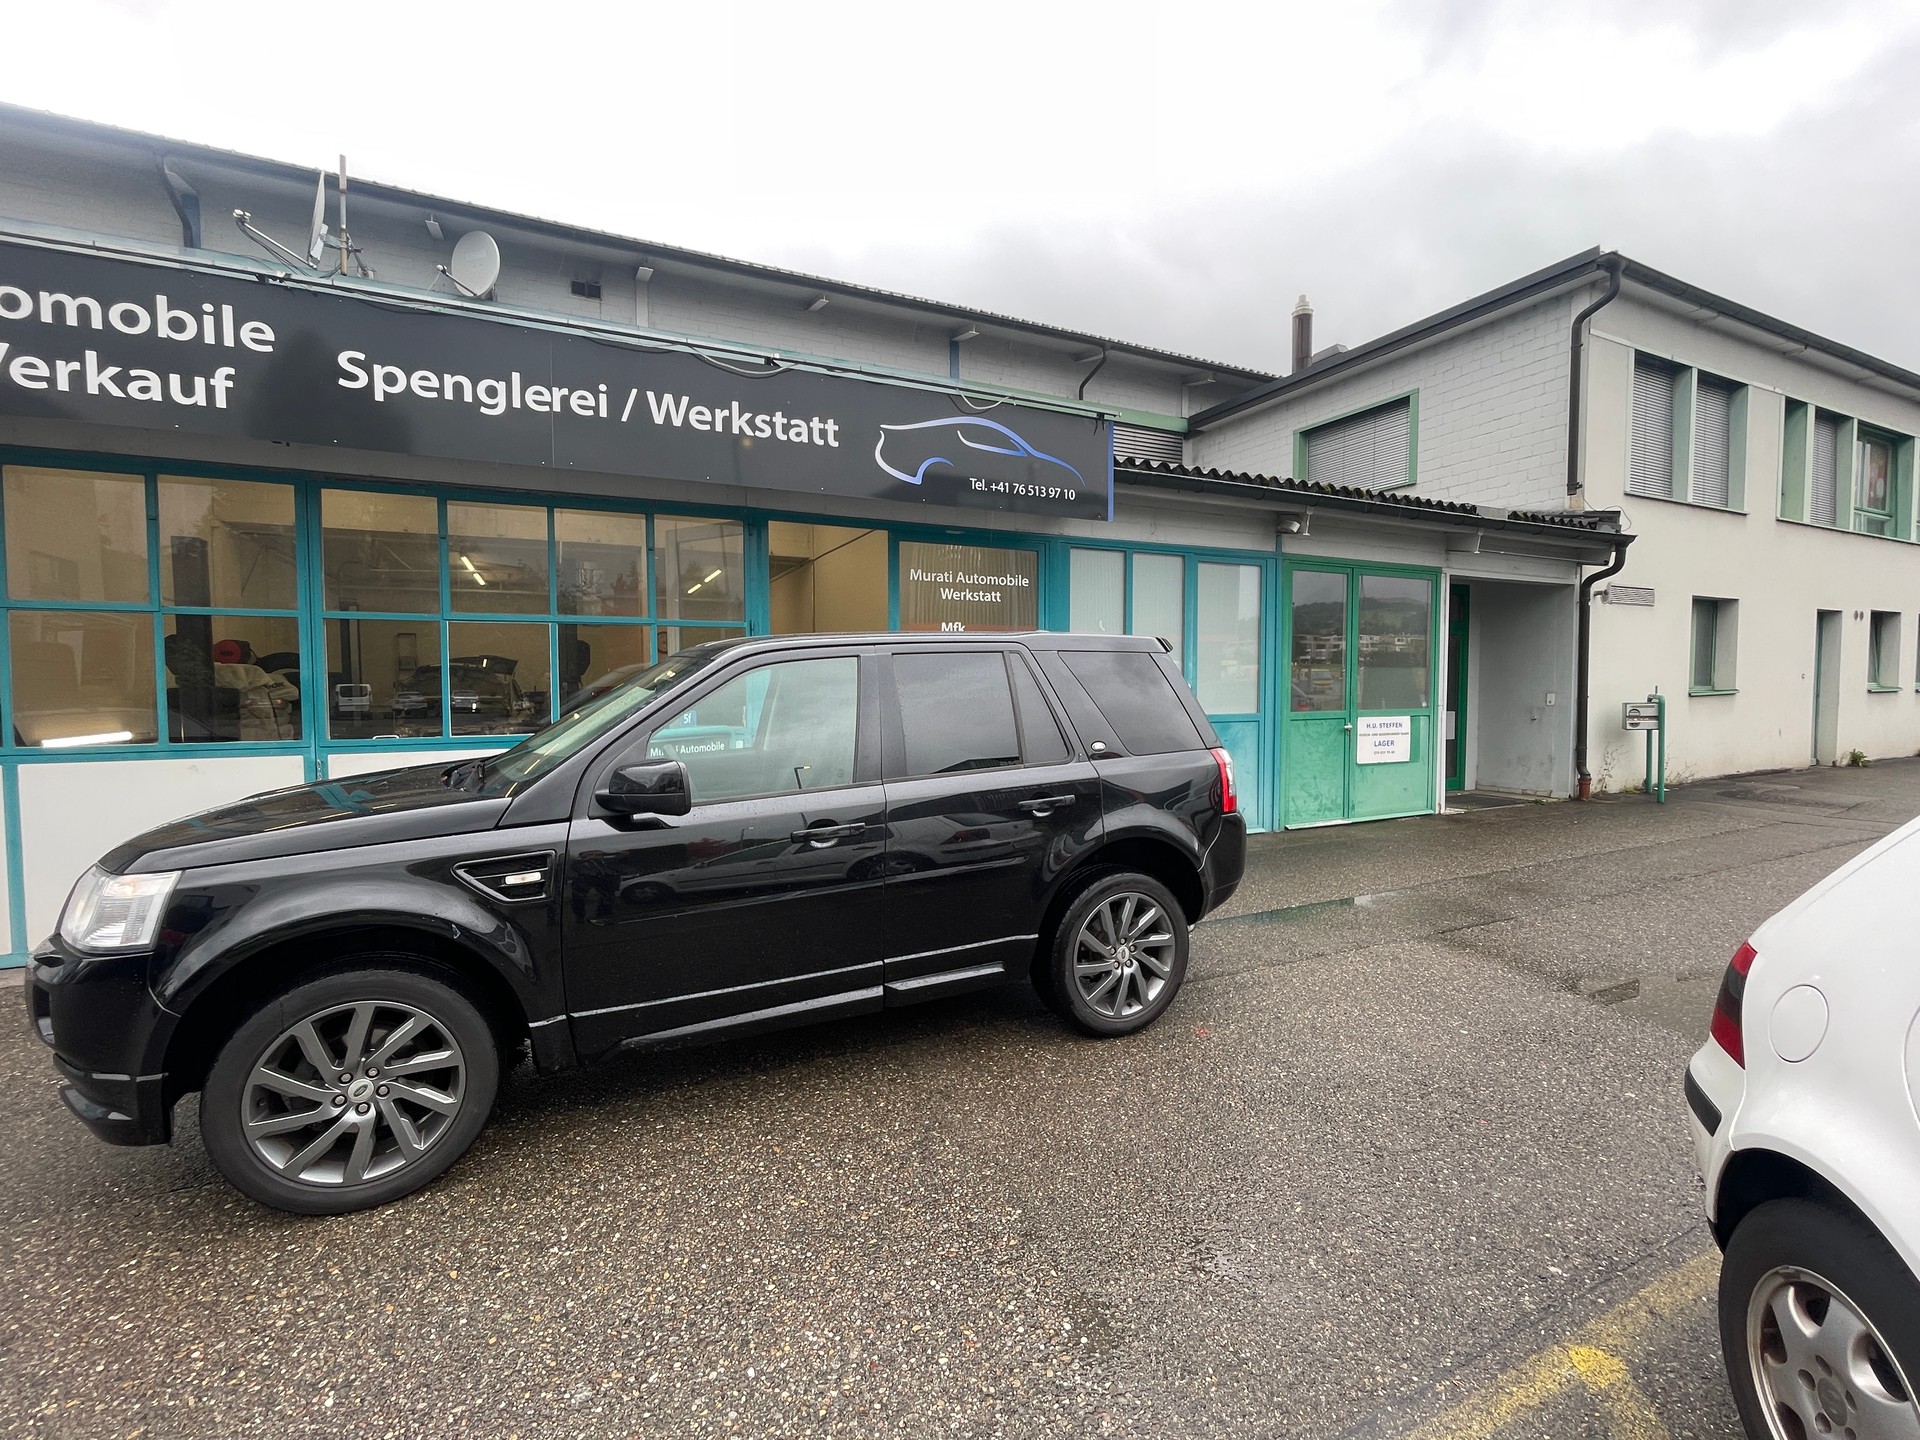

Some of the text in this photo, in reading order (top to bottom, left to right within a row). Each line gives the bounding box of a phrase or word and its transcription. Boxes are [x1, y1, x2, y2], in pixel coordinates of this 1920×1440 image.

[0, 285, 276, 353] omobile
[337, 350, 839, 448] Spenglerei / Werkstatt
[969, 477, 1076, 500] Tel. +41 76 513 97 10
[909, 568, 1030, 587] Murati Automobile
[940, 587, 1002, 603] Werkstatt
[941, 621, 966, 632] Mfk
[680, 741, 725, 754] Automobile
